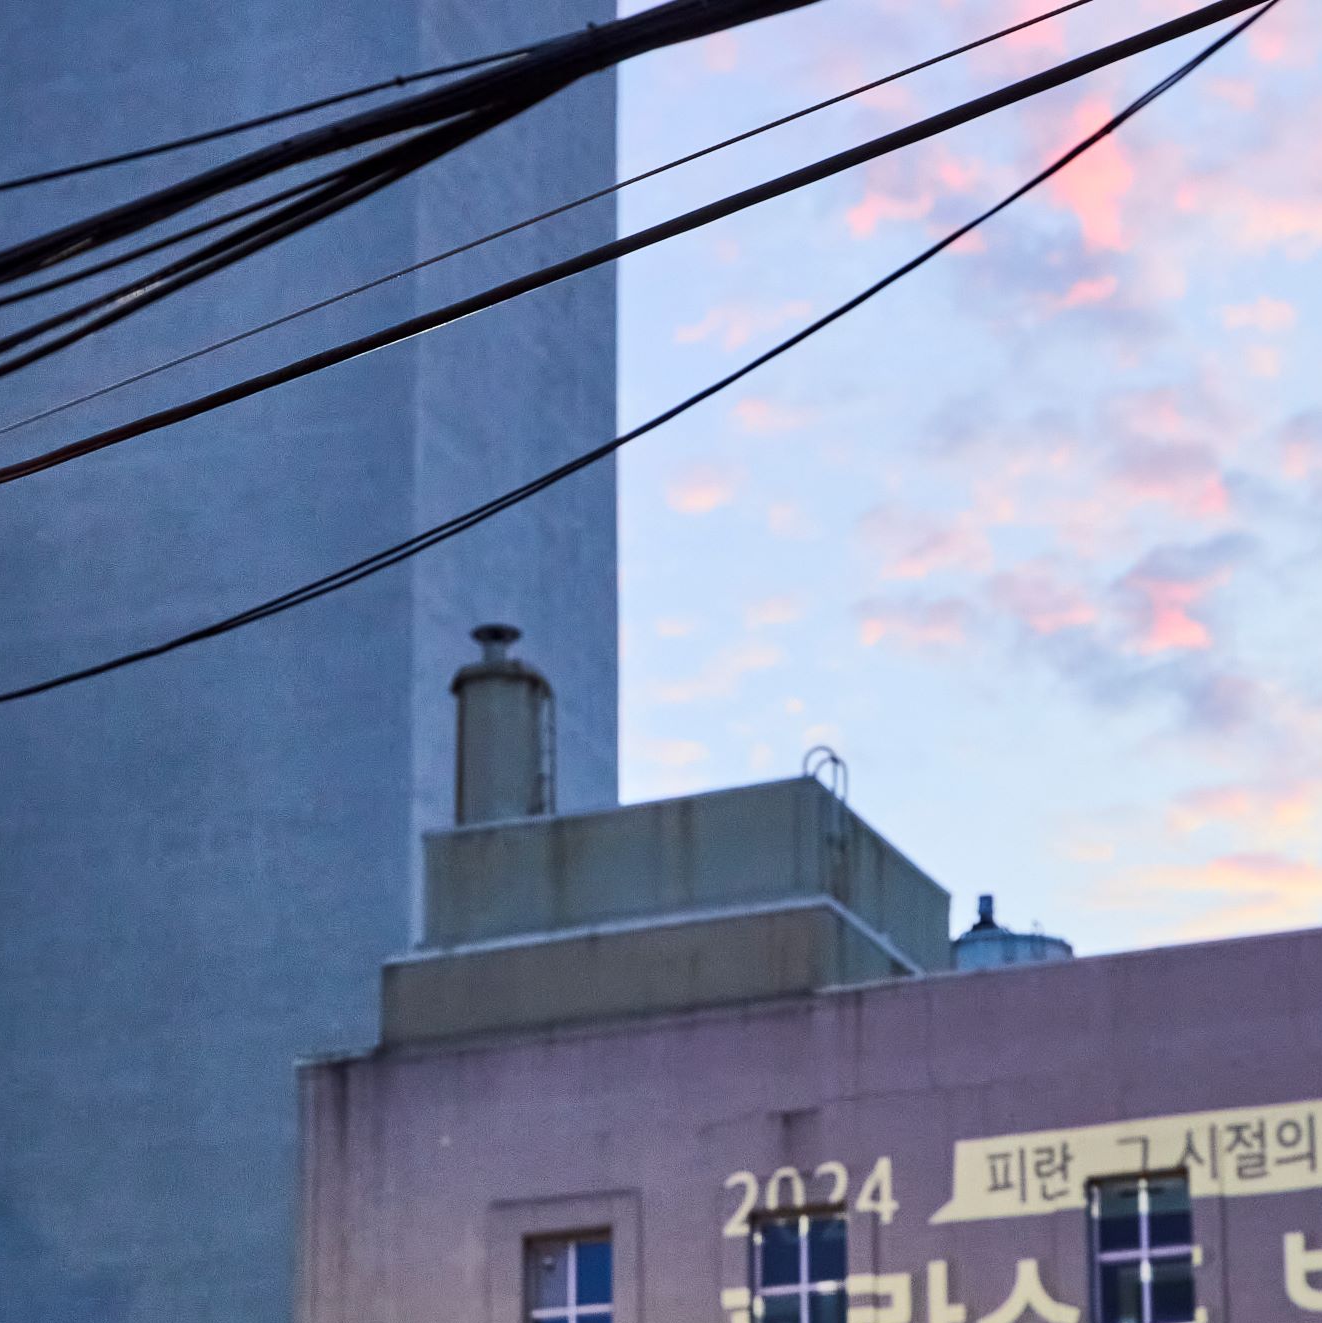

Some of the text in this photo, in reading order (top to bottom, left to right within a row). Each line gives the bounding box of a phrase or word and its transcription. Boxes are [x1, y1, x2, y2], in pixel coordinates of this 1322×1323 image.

[723, 1156, 900, 1237] 2024
[986, 1142, 1074, 1202] 피란
[1180, 1112, 1318, 1179] 시절의
